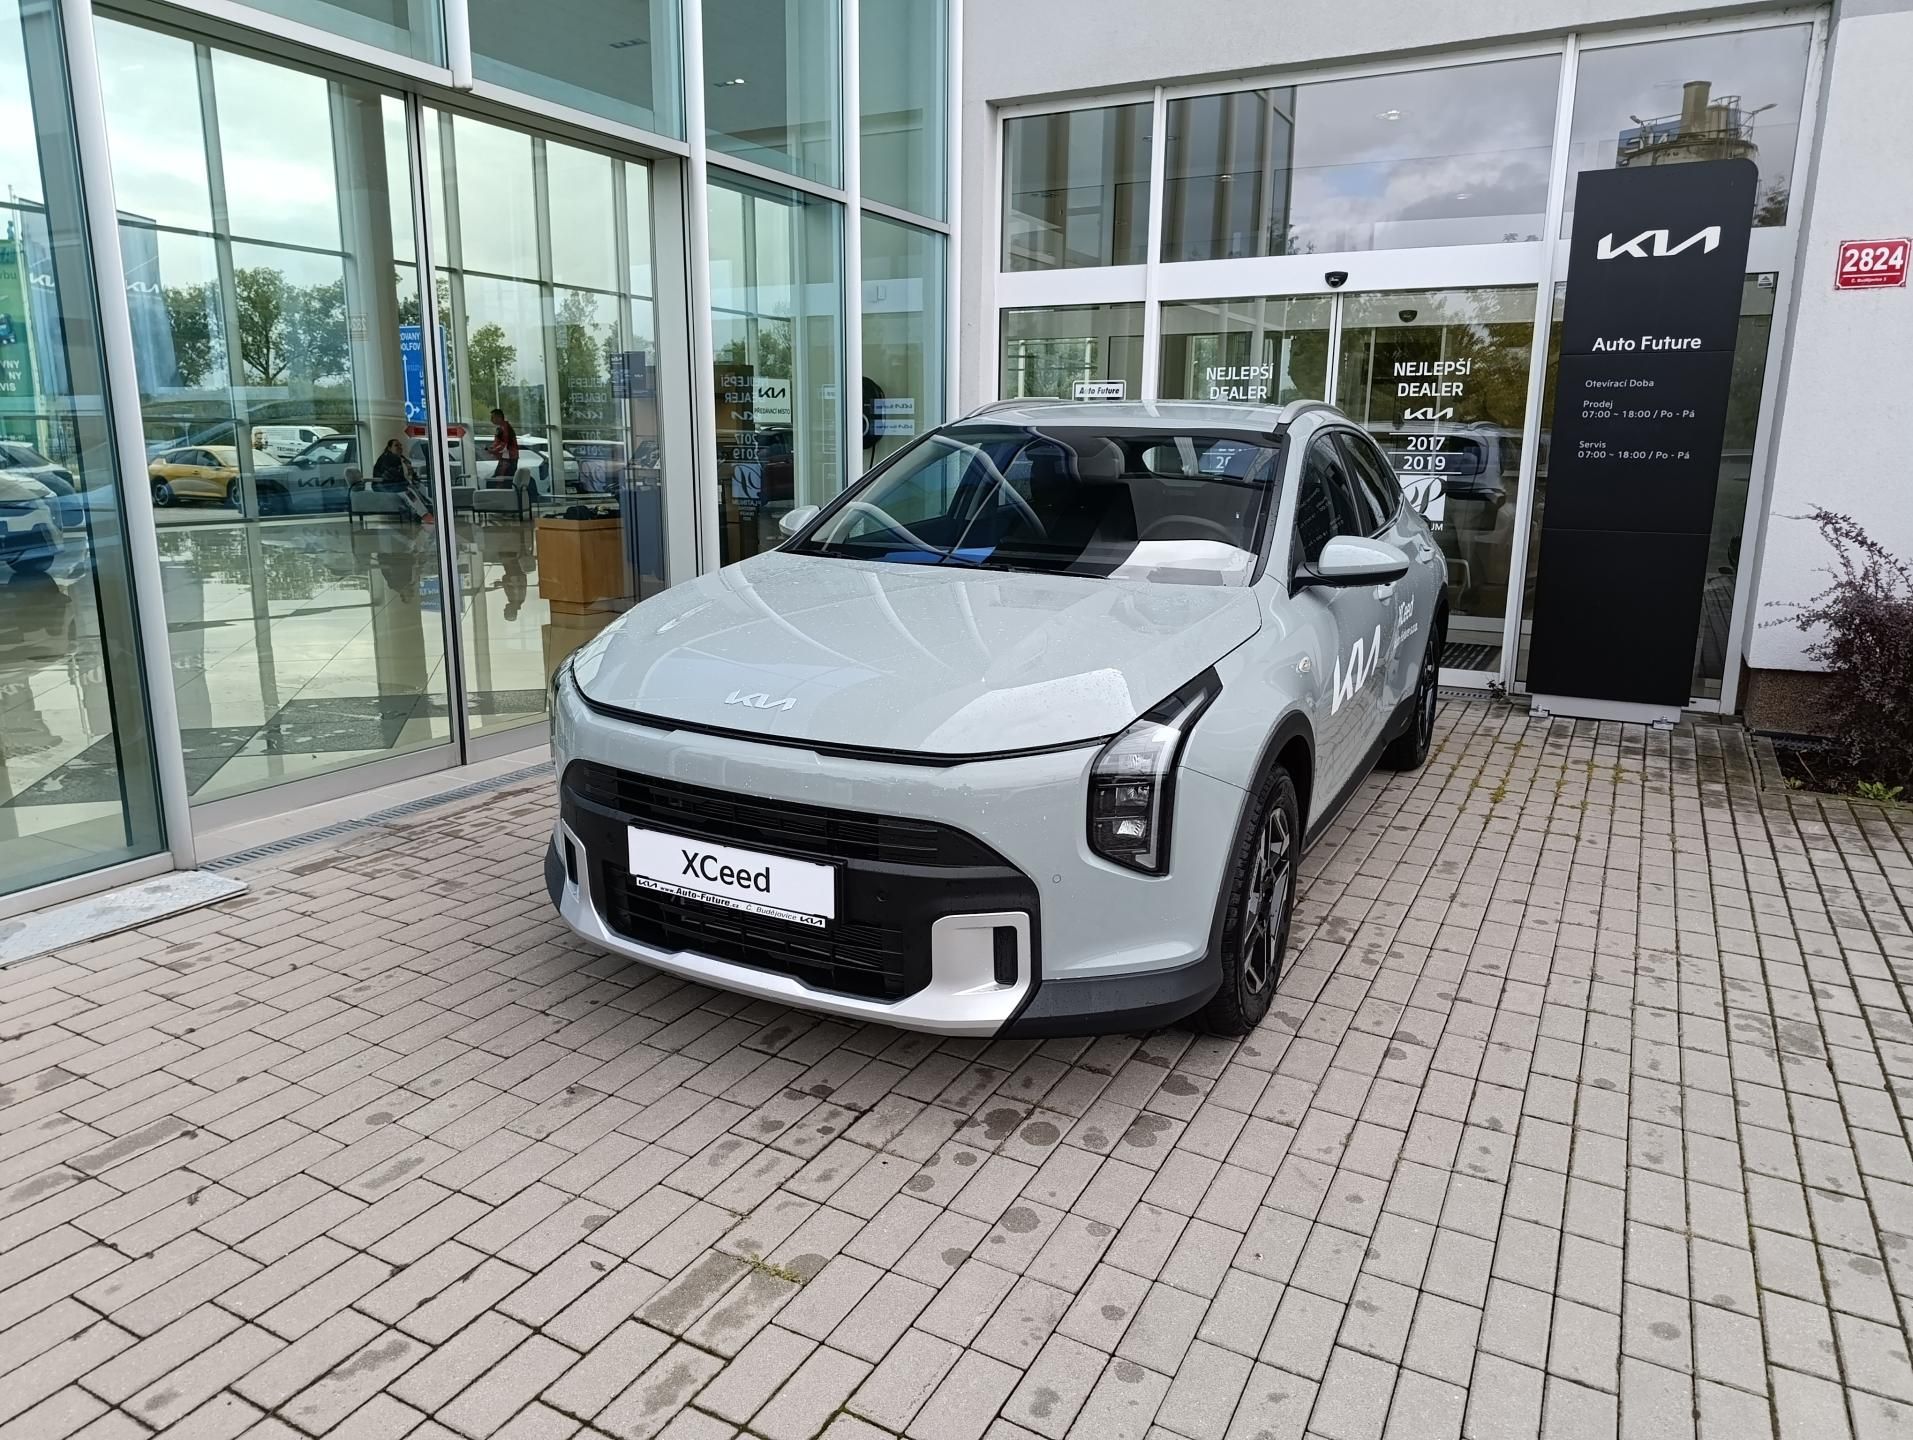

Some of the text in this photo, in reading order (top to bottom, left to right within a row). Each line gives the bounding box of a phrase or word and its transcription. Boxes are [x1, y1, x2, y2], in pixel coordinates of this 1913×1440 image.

[1597, 225, 1721, 260] KIA
[1842, 246, 1904, 272] 2824
[1592, 335, 1702, 352] Auto Future
[1206, 362, 1274, 380] NEJLEPŠÍ
[1393, 358, 1471, 376] NEJLEPŠÍ
[1097, 387, 1120, 395] Future
[1397, 382, 1464, 397] DEALER
[1585, 379, 1655, 388] Otevírací Doba
[1209, 385, 1267, 400] DEALER
[1583, 400, 1614, 409] Prodej
[1404, 407, 1454, 420] KIA
[1582, 410, 1611, 418] 07:00
[1622, 410, 1651, 418] 18:00
[1660, 410, 1673, 418] Po
[1682, 409, 1695, 418] Pá
[1406, 436, 1446, 450] 2017
[1579, 440, 1606, 448] Servis
[1577, 450, 1606, 459] 07:00
[1618, 451, 1646, 459] 18:00
[1655, 451, 1668, 459] Po
[1677, 450, 1690, 459] Pá
[1402, 456, 1446, 470] 2019
[1331, 624, 1381, 716] KIA
[724, 688, 797, 712] KIA
[681, 849, 771, 893] XCeed
[756, 906, 797, 921] Budějovice
[800, 915, 823, 926] KIA
